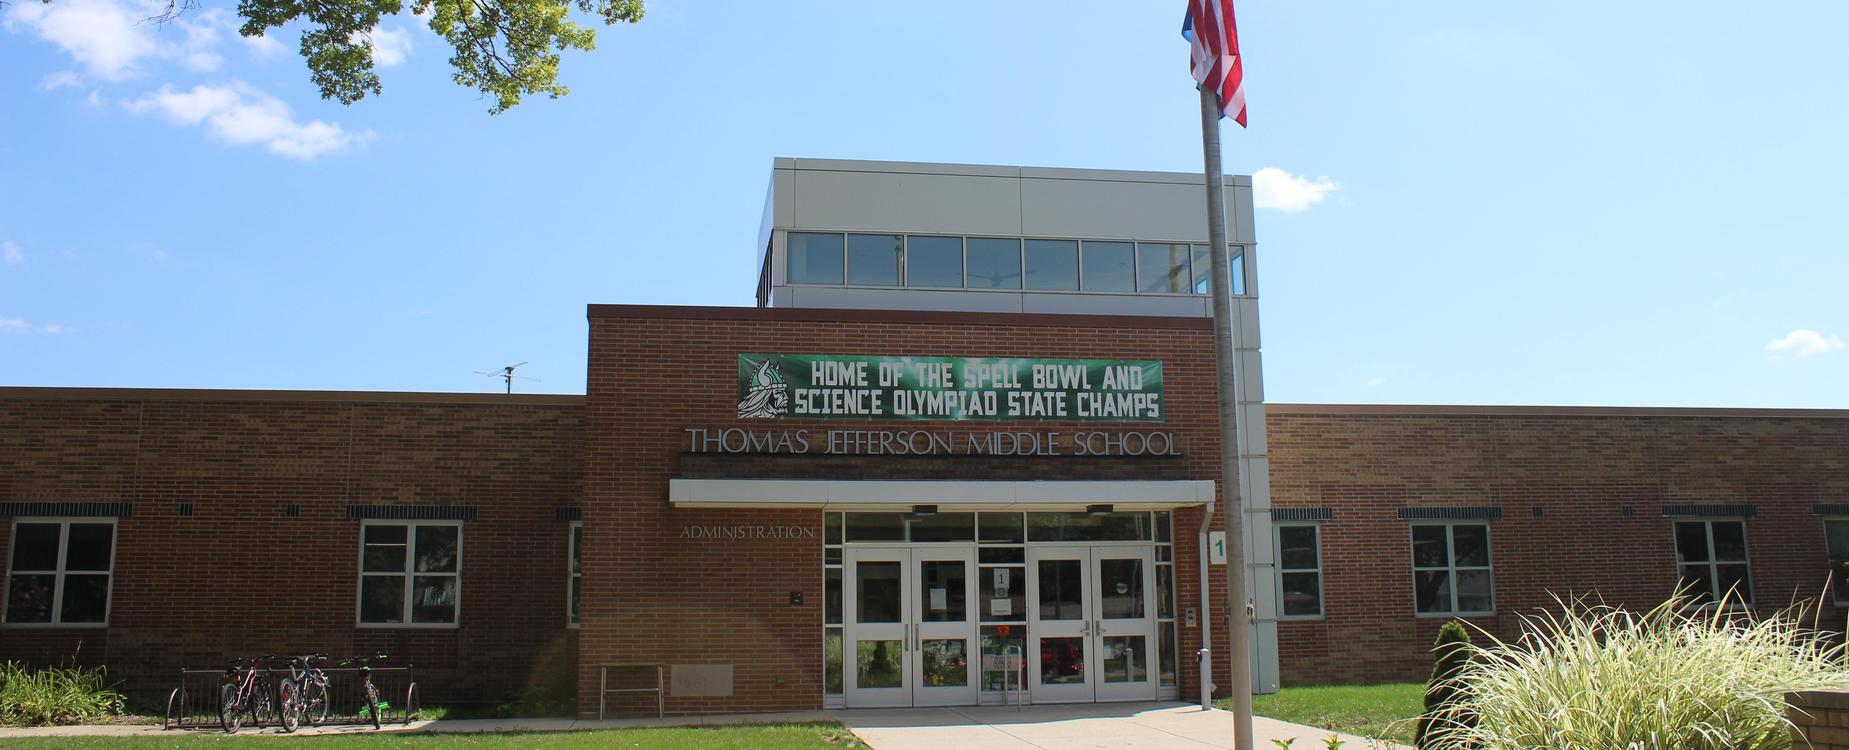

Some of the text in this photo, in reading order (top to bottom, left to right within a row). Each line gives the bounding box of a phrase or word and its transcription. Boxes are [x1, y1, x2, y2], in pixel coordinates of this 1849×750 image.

[812, 361, 1143, 391] HOME OF THE SPELL BOWL AND
[795, 388, 1160, 418] SCIENCE OLYMPIAD STATE CHAMPS
[684, 428, 1181, 456] THOMAS JEFFERSON MIDDLE SCHOOL
[680, 525, 815, 539] ADMINISTRATION
[1215, 539, 1224, 557] 1
[998, 573, 1005, 584] 1
